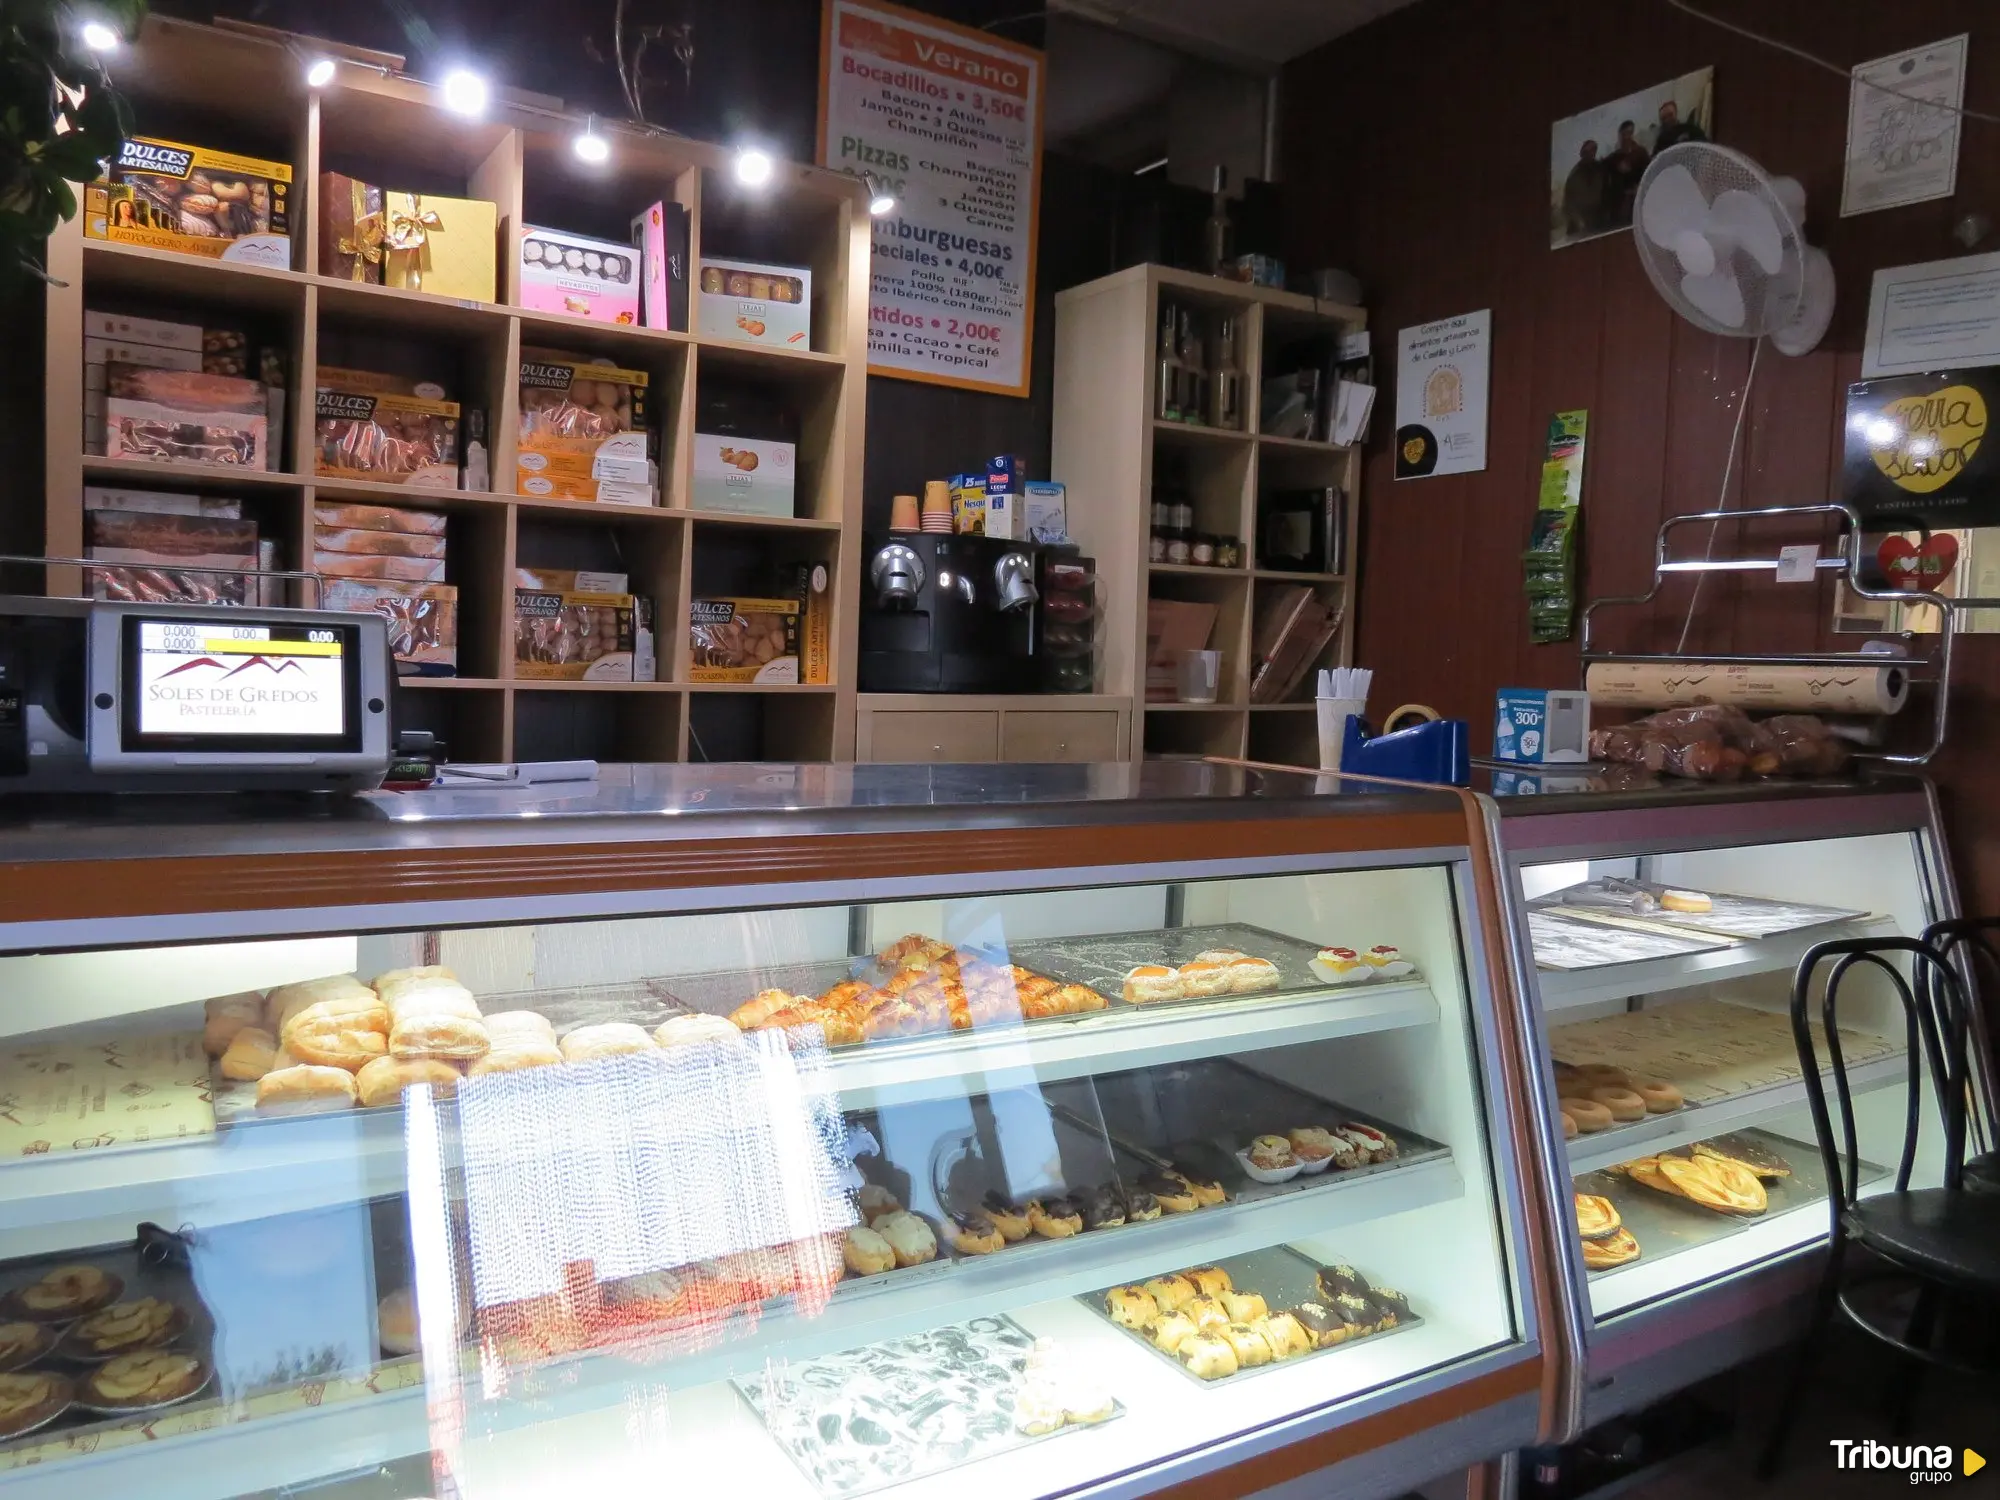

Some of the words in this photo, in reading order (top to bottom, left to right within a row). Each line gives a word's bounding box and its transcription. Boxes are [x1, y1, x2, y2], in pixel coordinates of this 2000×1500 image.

[913, 39, 1020, 88] Verano
[842, 56, 949, 100] Bocadillos
[972, 92, 1025, 122] 3,50€
[881, 90, 930, 111] Bacon
[949, 107, 986, 126] Atún
[860, 98, 914, 120] Jamón
[933, 117, 942, 127] 3
[947, 121, 1003, 144] Quesos
[887, 119, 978, 150] Champiñón
[118, 155, 186, 176] ARTESANOS
[122, 142, 190, 167] DULCES
[841, 136, 910, 171] Pizzas
[919, 160, 1016, 191] Champiñón
[966, 160, 1016, 180] Bacon
[939, 197, 947, 207] 3
[954, 201, 1014, 222] Quesos
[961, 192, 1015, 211] Jamón
[966, 215, 1014, 233] Carne
[873, 217, 1013, 261] mburguesas
[870, 240, 939, 268] peciales
[958, 258, 1004, 280] 4,00€
[910, 279, 945, 295] 100%
[911, 269, 945, 283] Pollo
[892, 286, 939, 304] Ibérico
[943, 296, 967, 309] con
[969, 302, 1012, 318] Jamón
[870, 306, 924, 330] tidos
[947, 319, 1001, 343] 2,00€
[904, 332, 949, 349] Cacao
[967, 341, 1000, 358] Café
[929, 349, 989, 369] Tropical
[520, 364, 572, 380] DULCES
[317, 394, 373, 411] DULCES
[964, 500, 985, 510] Nesqu
[691, 613, 730, 622] RTESANOS
[149, 684, 204, 702] SOLES
[211, 688, 234, 701] DE
[239, 686, 318, 703] GREDOS
[1515, 712, 1538, 725] 300
